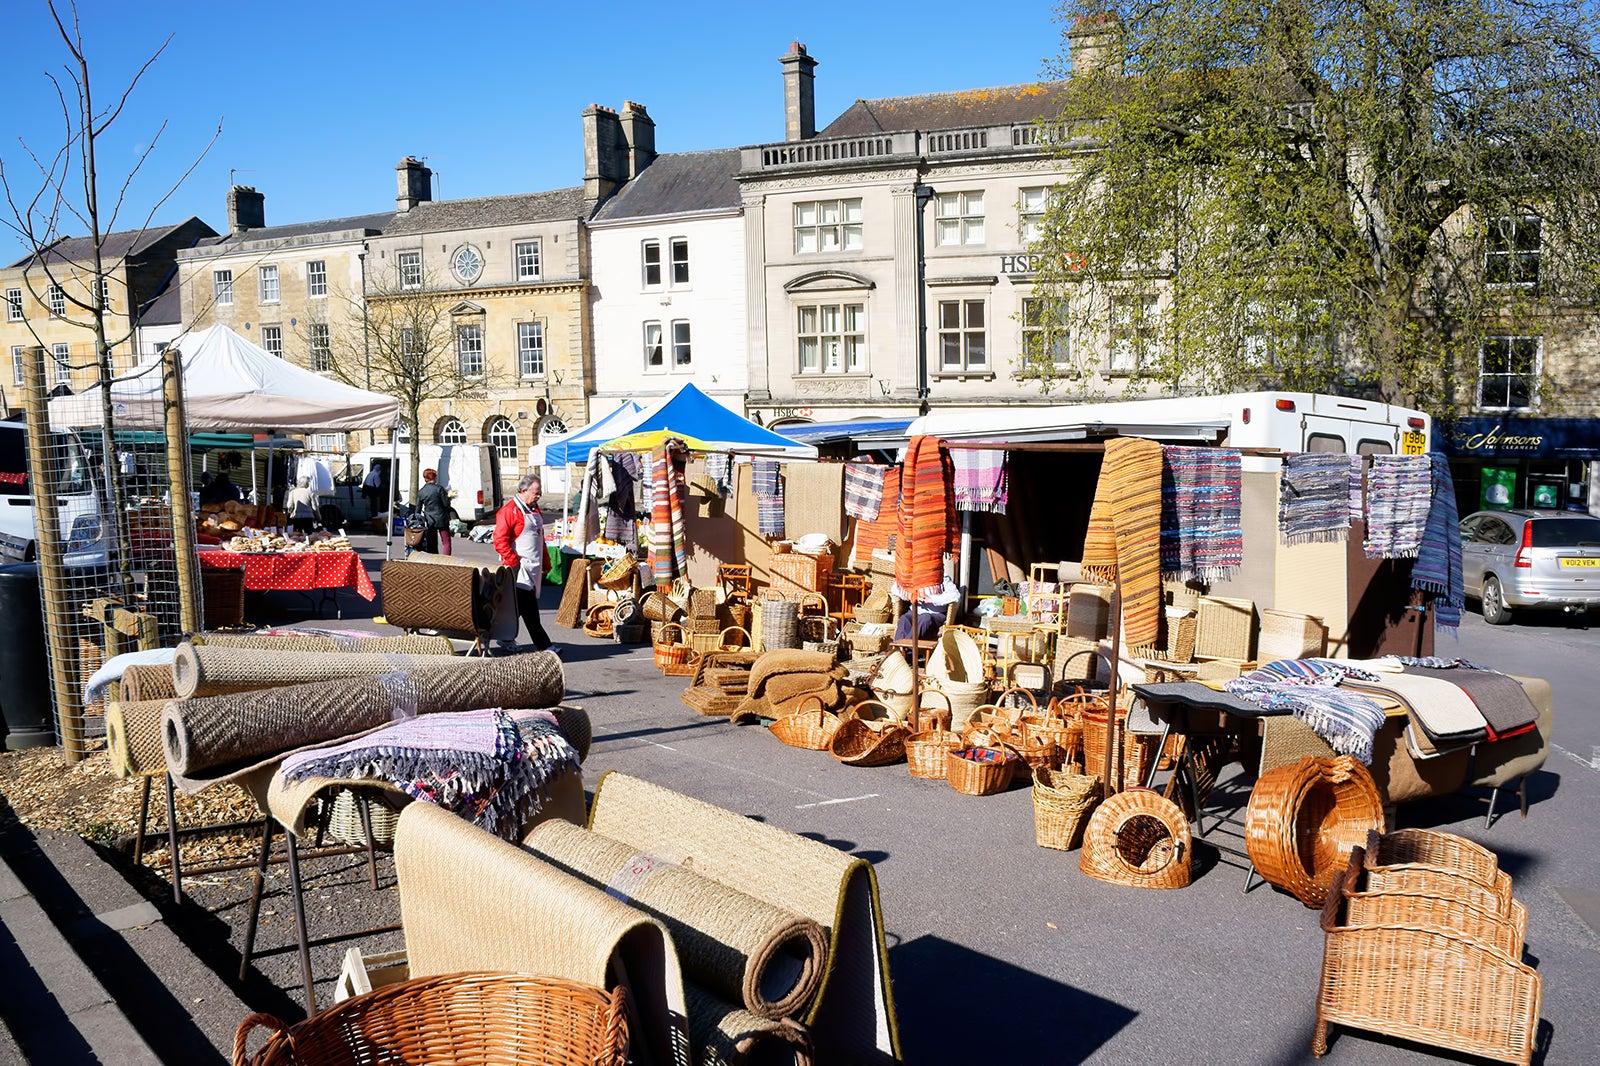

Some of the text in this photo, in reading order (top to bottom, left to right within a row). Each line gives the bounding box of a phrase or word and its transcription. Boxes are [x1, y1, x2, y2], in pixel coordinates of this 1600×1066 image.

[1000, 255, 1042, 273] HSB
[773, 407, 799, 417] HSBC
[1404, 431, 1426, 445] T980
[1466, 425, 1543, 449] Johnsons
[1406, 445, 1422, 455] TPT
